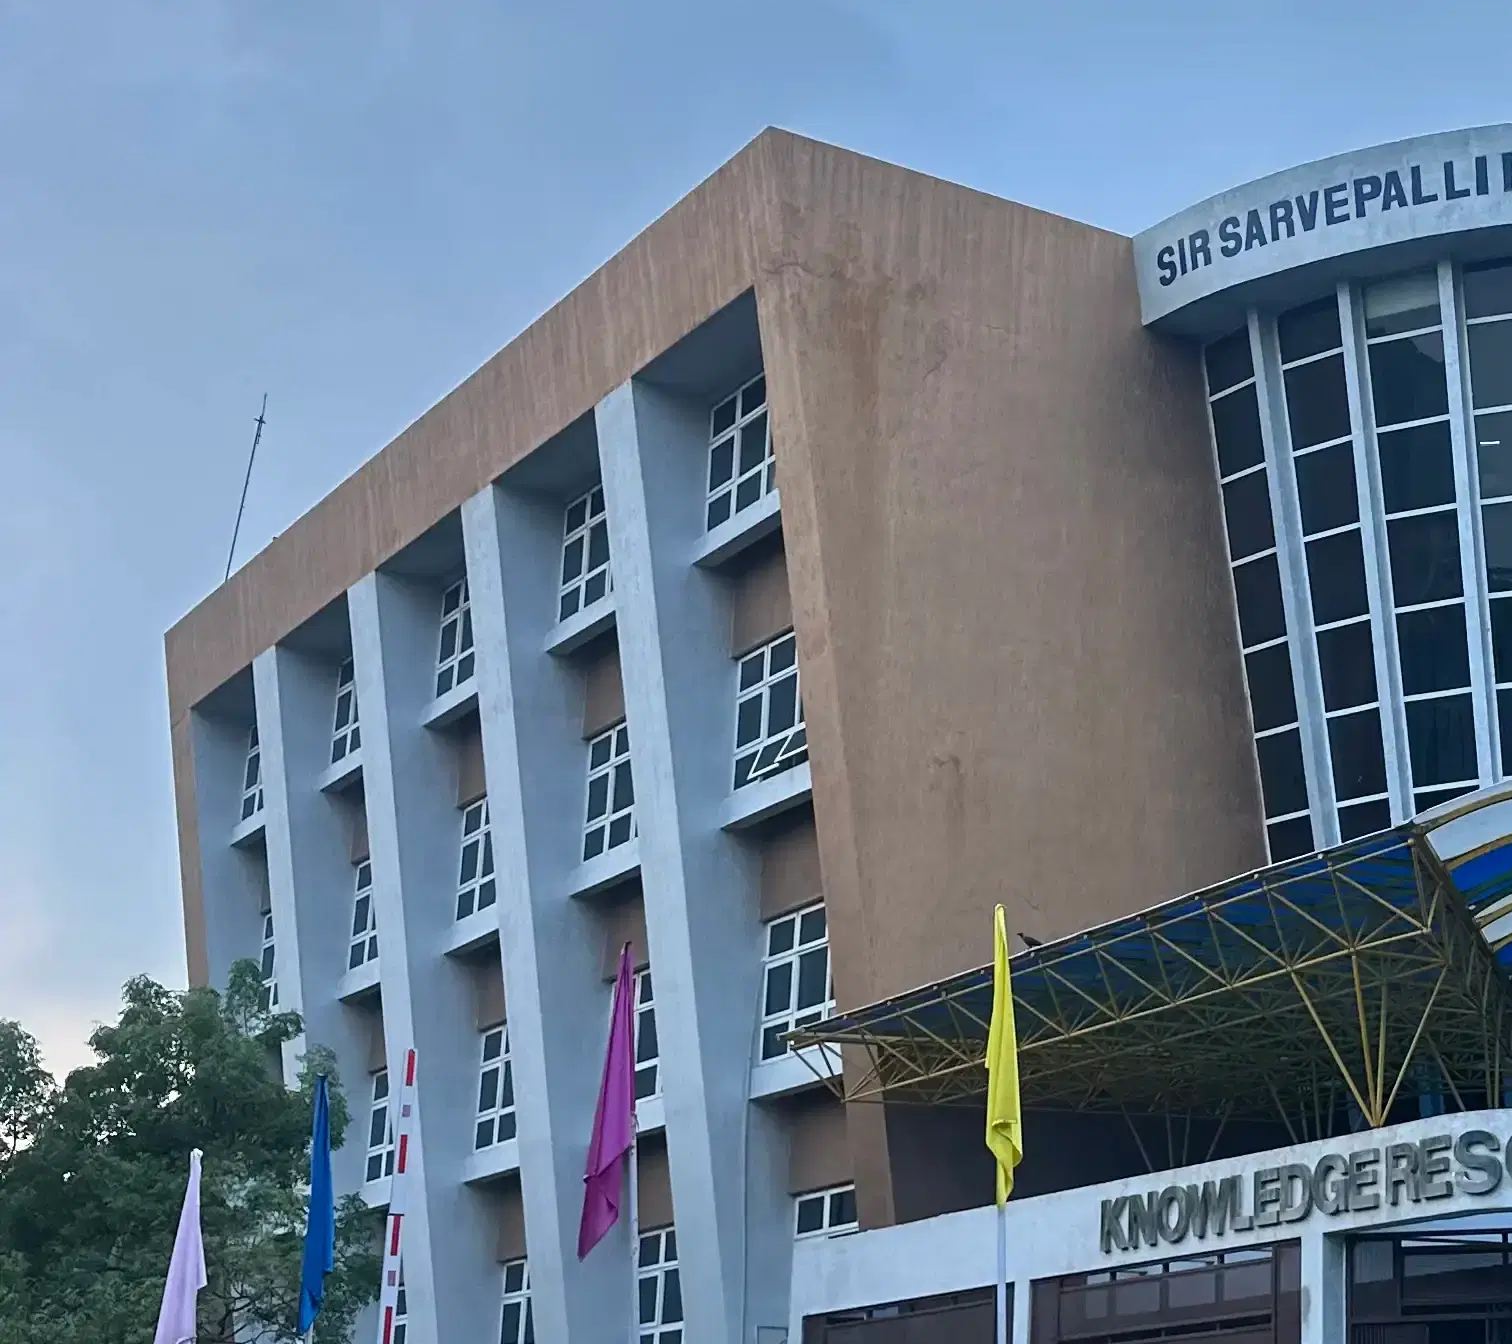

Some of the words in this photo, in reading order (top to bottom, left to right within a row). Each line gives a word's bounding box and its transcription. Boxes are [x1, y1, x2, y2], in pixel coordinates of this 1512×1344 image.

[1156, 228, 1212, 287] SIR
[1218, 155, 1489, 258] SARVEPALLI
[1099, 1147, 1381, 1254] KNOWLEDGE
